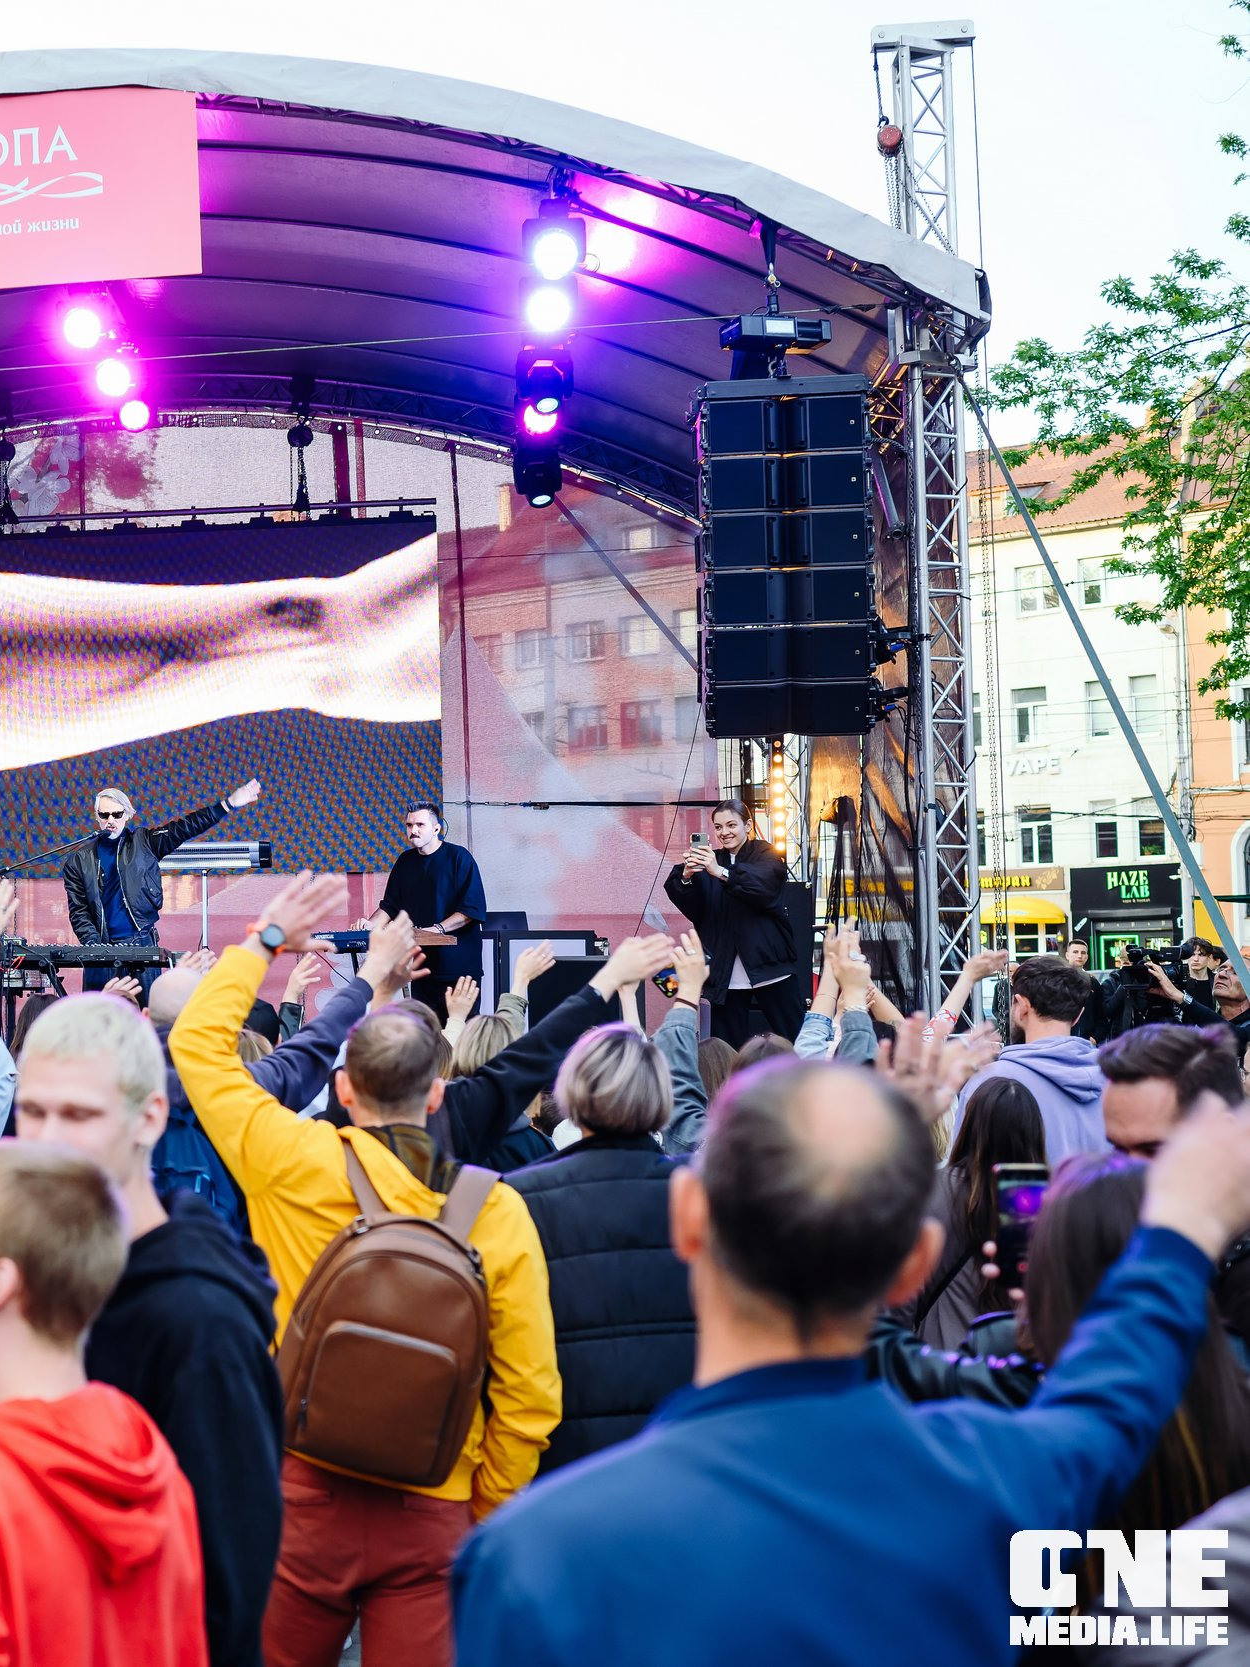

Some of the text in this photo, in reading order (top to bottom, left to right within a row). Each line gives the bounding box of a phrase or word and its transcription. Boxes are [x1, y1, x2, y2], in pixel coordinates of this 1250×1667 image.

[27, 217, 79, 232] жизни
[1006, 757, 1061, 776] VAPE
[1106, 870, 1149, 890] HAZE
[1121, 885, 1150, 899] LAB
